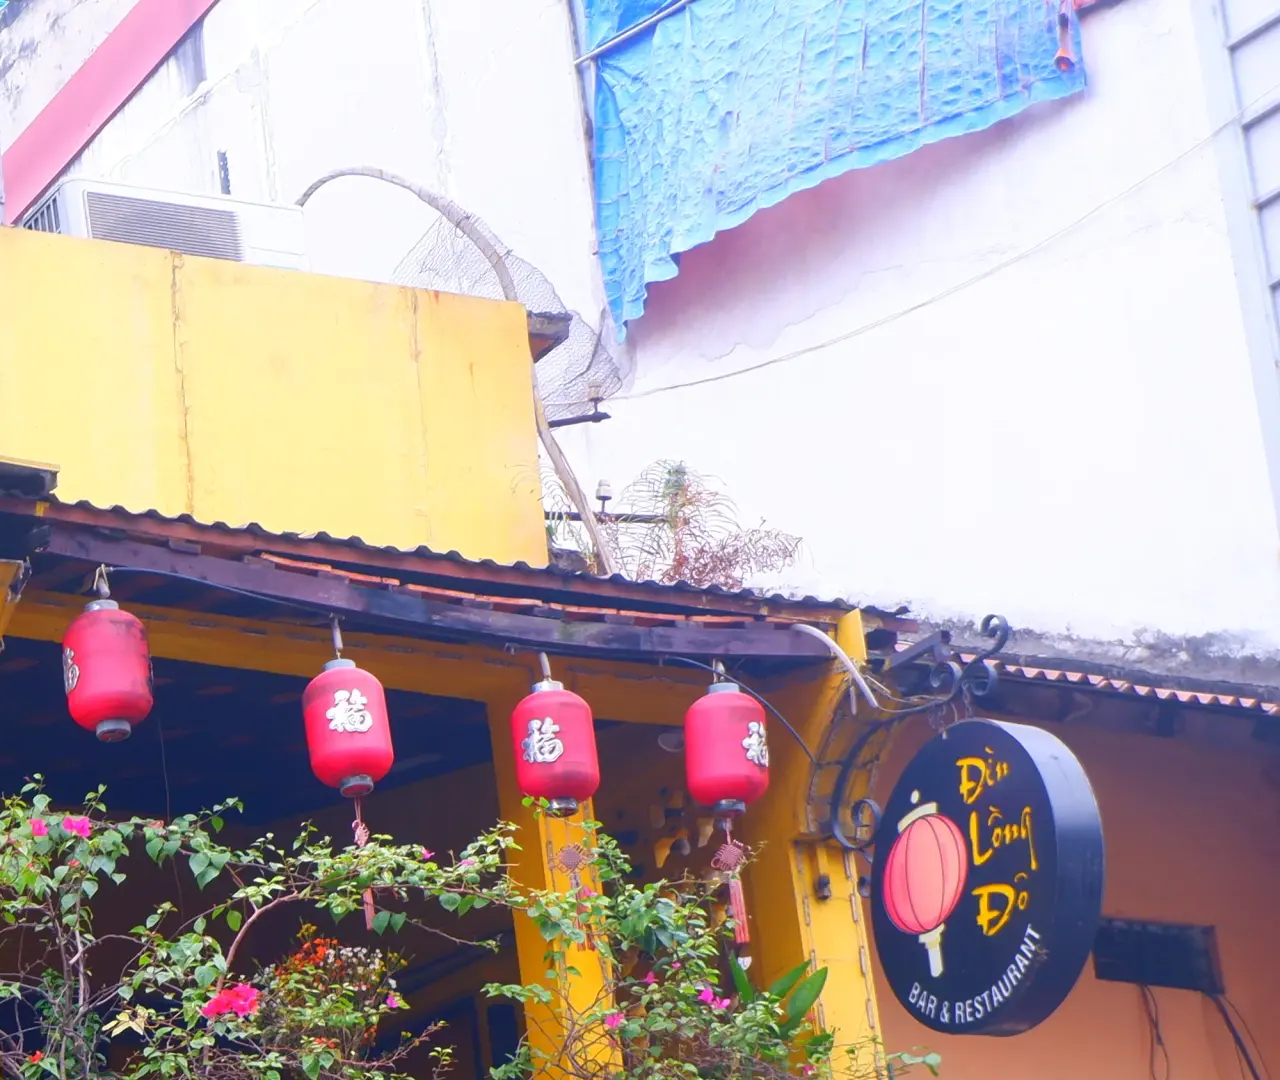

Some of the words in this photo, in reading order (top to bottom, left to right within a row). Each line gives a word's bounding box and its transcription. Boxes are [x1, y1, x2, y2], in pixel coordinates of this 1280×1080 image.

[908, 981, 938, 1019] BAR
[940, 1001, 951, 1024] &
[954, 923, 1043, 1025] RESTAURANT
